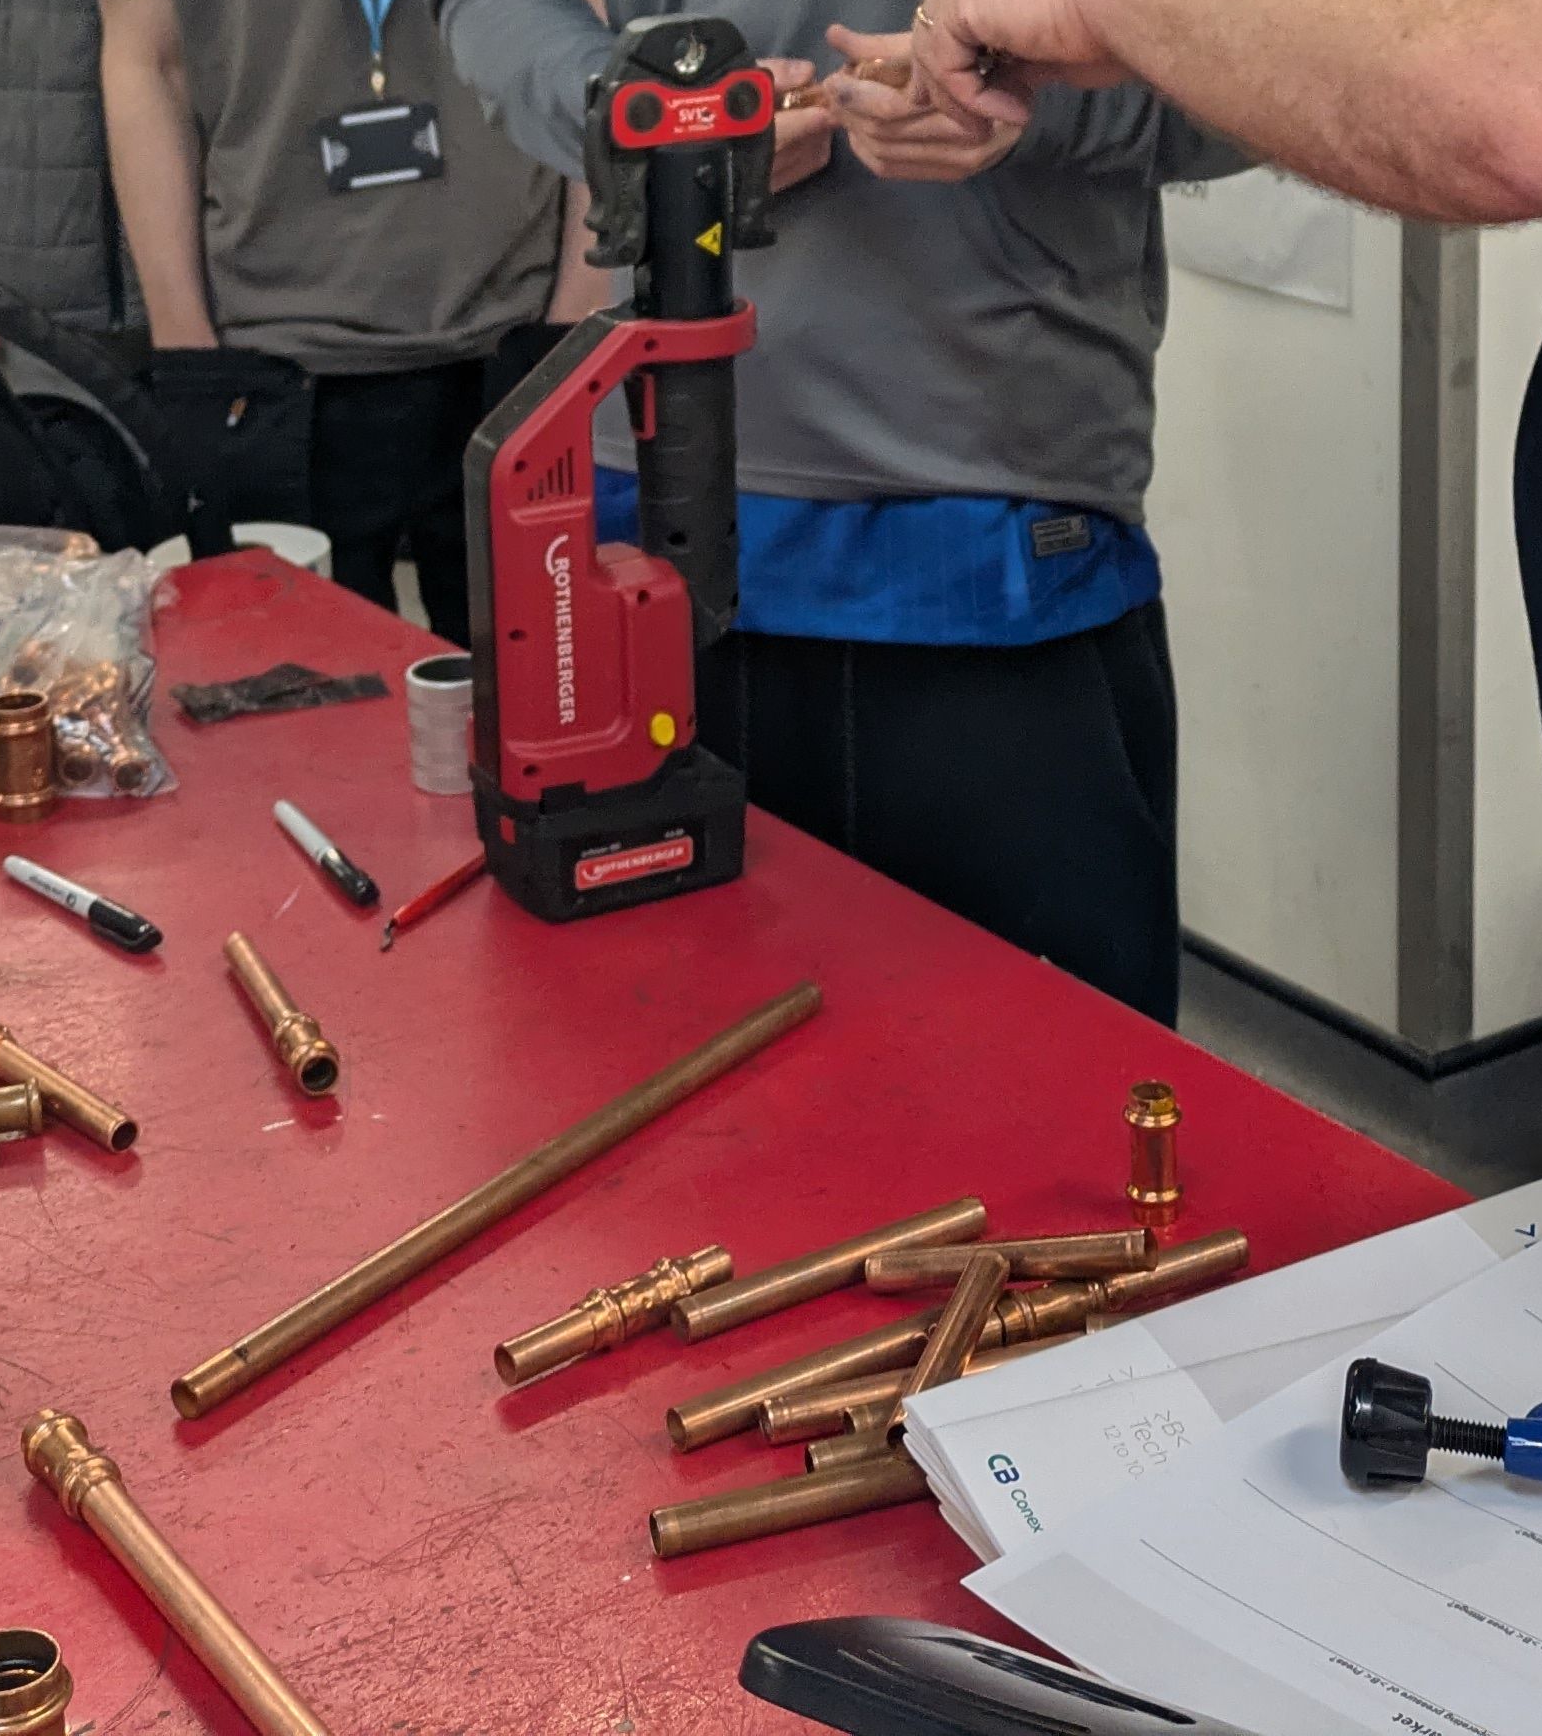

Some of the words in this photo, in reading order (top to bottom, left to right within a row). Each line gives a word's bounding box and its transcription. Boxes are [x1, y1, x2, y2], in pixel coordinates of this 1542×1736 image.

[545, 534, 577, 727] ROTHENBERGER
[1129, 1416, 1169, 1466] Tech
[986, 1452, 1021, 1485] CB
[1009, 1487, 1044, 1534] Conex
[1486, 1618, 1516, 1637] Press
[1328, 1655, 1365, 1676] Press?
[1386, 1684, 1401, 1694] of
[1399, 1690, 1446, 1717] pressure
[1443, 1711, 1496, 1736] perating
